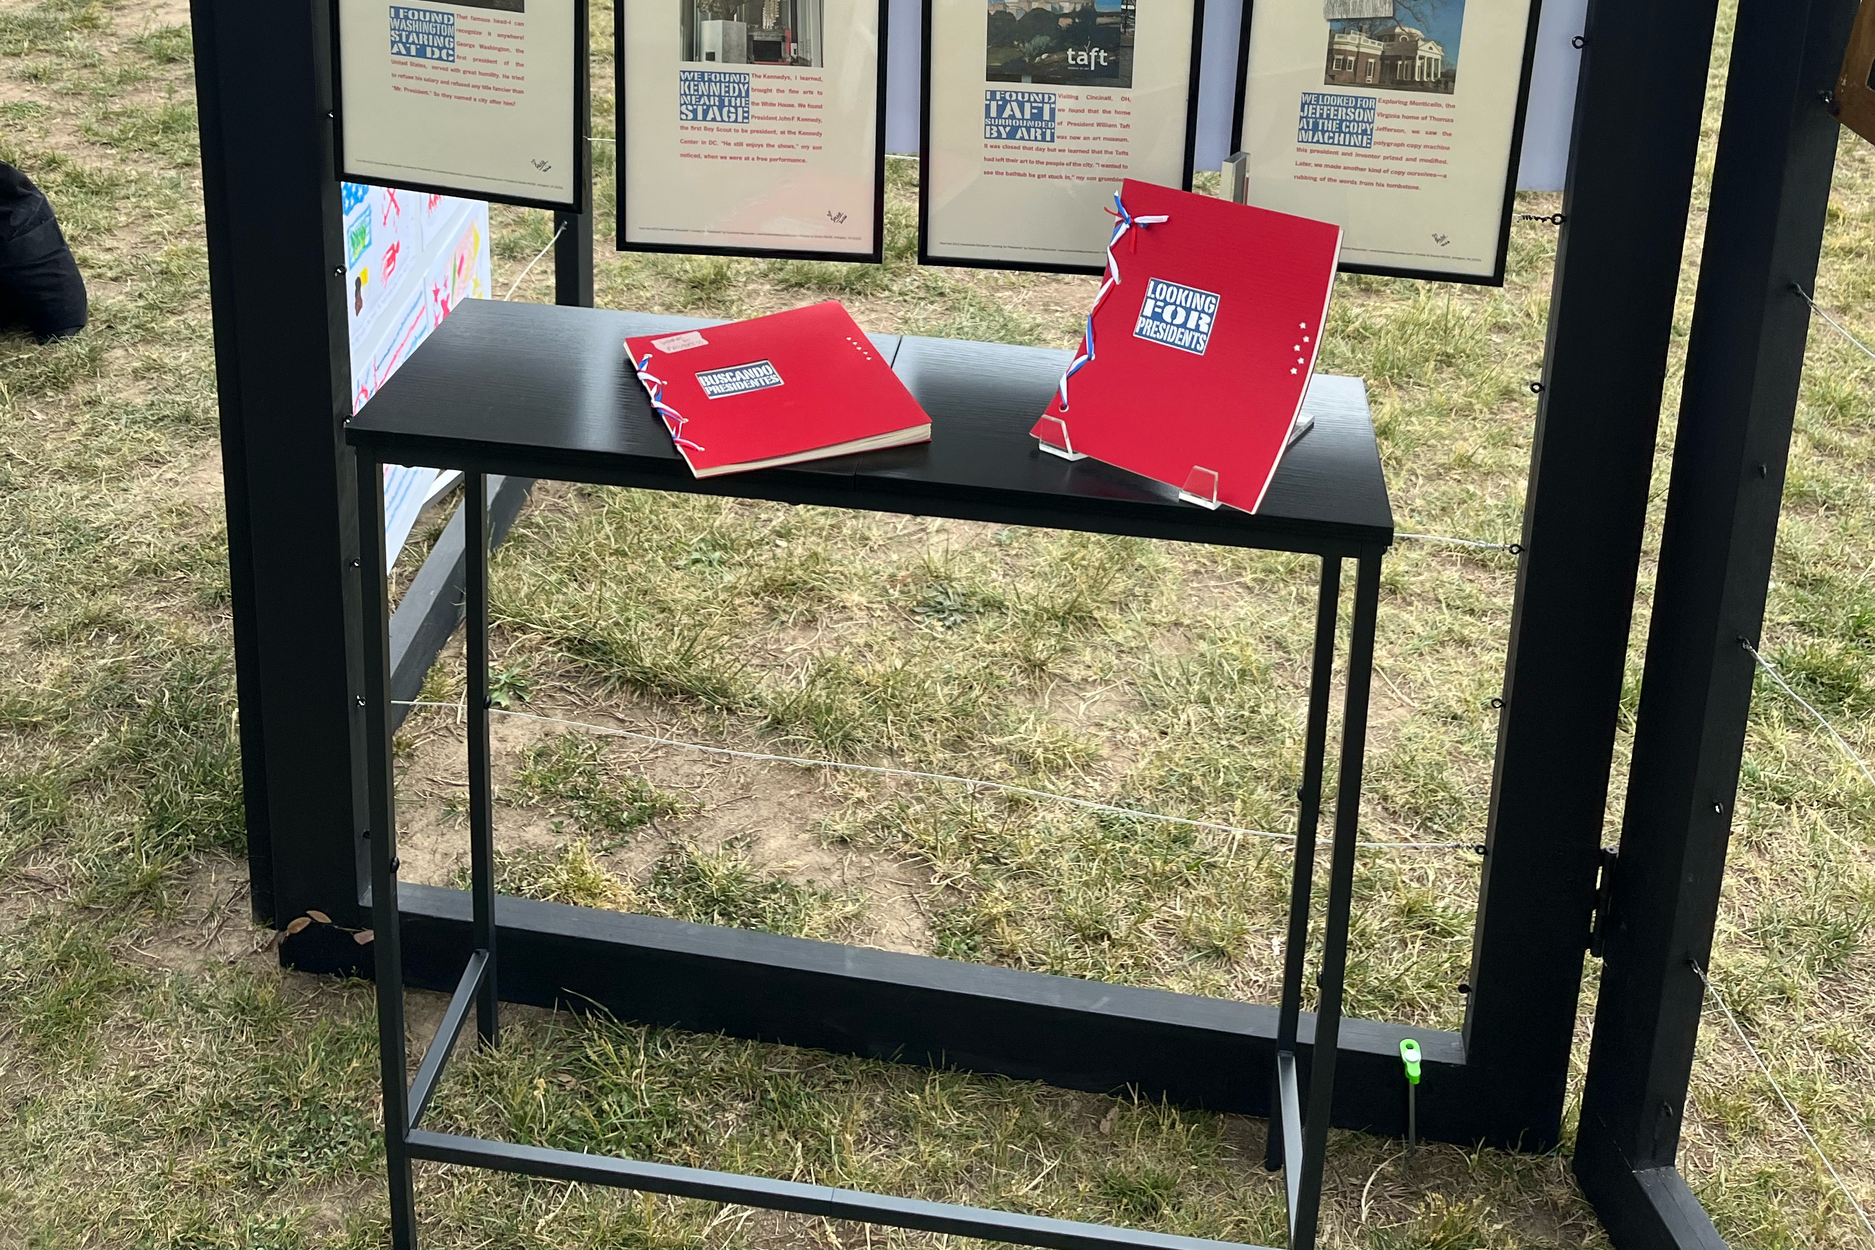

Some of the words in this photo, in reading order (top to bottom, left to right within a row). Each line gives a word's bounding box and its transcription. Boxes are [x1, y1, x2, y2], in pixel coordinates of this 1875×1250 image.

[390, 8, 395, 17] I
[399, 9, 454, 24] FOUND
[390, 18, 453, 37] WASHINGTON
[391, 31, 453, 48] STARING
[391, 43, 420, 56] AT
[426, 47, 454, 61] DC
[1067, 47, 1108, 70] taft
[680, 72, 701, 81] WE
[704, 73, 749, 82] FOUND
[680, 81, 748, 96] KENNEDY
[986, 91, 991, 100] I
[996, 92, 1056, 102] FOUND
[680, 96, 719, 105] NEAR
[722, 97, 748, 106] THE
[1301, 94, 1317, 104] WE
[1319, 95, 1355, 106] LOOKED
[1357, 98, 1375, 109] FOR
[680, 105, 748, 122] STAGE
[985, 101, 1054, 120] TAFT
[1300, 105, 1374, 122] JEFFERSON
[985, 119, 1054, 128] SURROUNDED
[1299, 118, 1316, 129] AT
[1317, 120, 1340, 131] THE
[1342, 122, 1374, 134] COPY
[986, 126, 1011, 138] BY
[1015, 128, 1054, 141] ART
[1298, 130, 1371, 147] MACHINE
[1147, 281, 1216, 313] LOOKING
[1143, 298, 1211, 333] FOR
[1135, 317, 1206, 351] PRESIDENTS
[698, 364, 773, 386] BUSCANDO
[704, 374, 780, 395] PRESIDENTES
